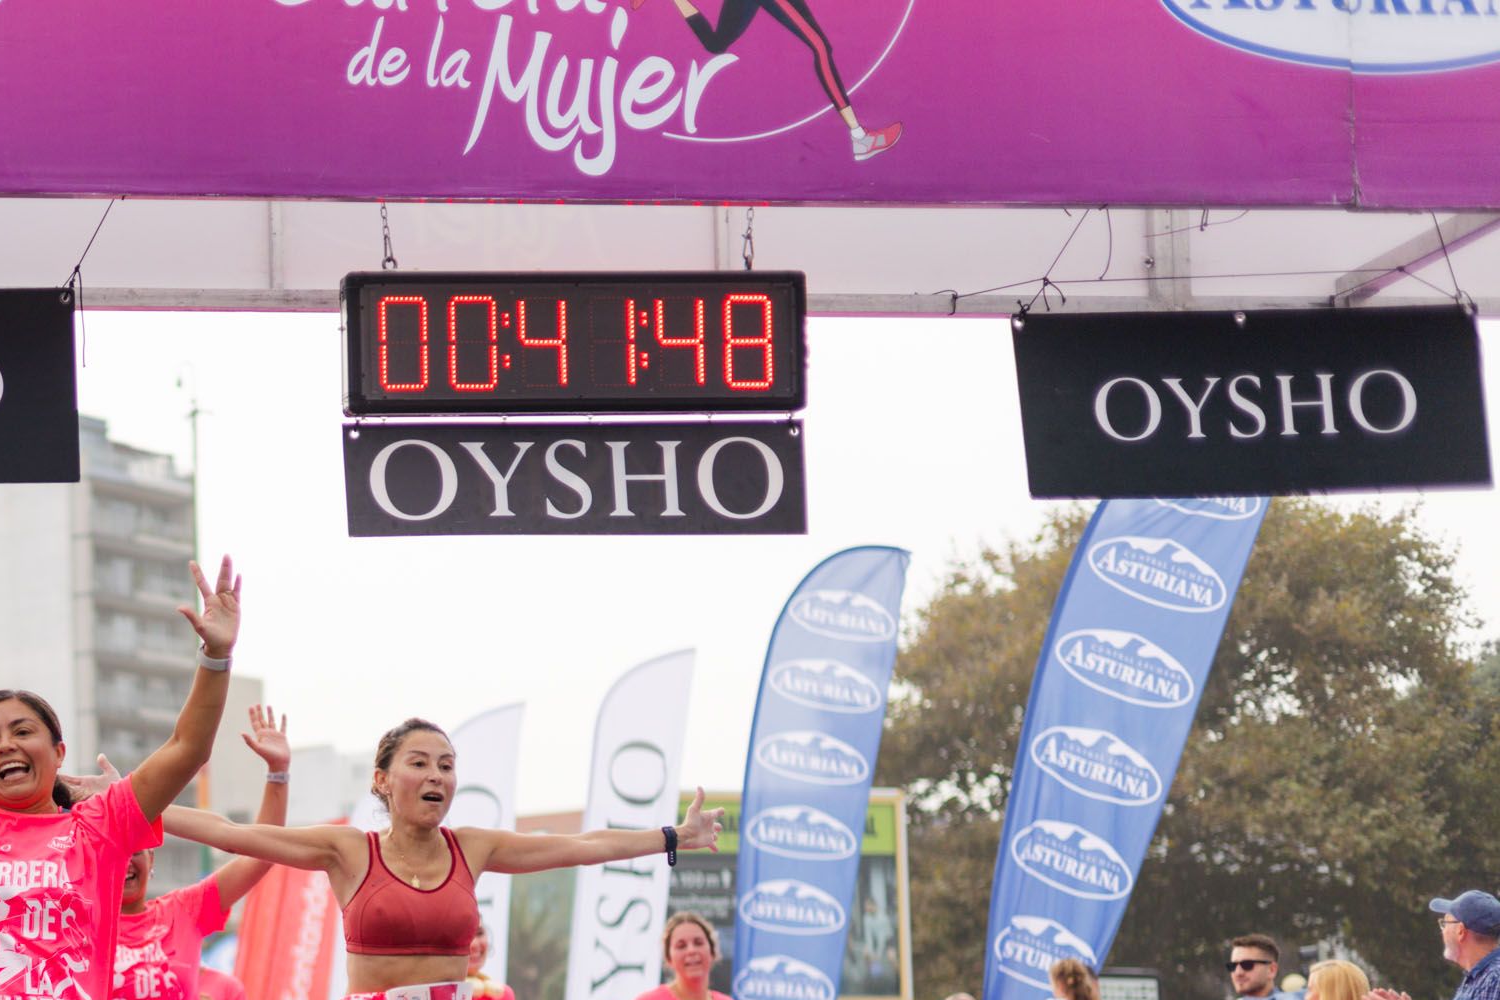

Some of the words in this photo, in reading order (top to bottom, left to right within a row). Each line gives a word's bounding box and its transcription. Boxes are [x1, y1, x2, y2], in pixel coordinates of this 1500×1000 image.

[346, 16, 411, 87] de
[426, 14, 472, 88] la
[462, 7, 740, 176] Mujer
[1095, 370, 1417, 441] OYSHO
[369, 437, 784, 521] OYSHO
[1098, 547, 1214, 606] ASTURIANA
[801, 602, 887, 634] ASTURIANA
[781, 671, 872, 707] ASTURIANA
[1066, 640, 1181, 702] ASTURIANA
[766, 744, 860, 778] ASTURIANA
[1041, 736, 1149, 799] ASTURIANA
[756, 819, 847, 852] ASTURIANA
[1021, 842, 1119, 895] ASTURIANA
